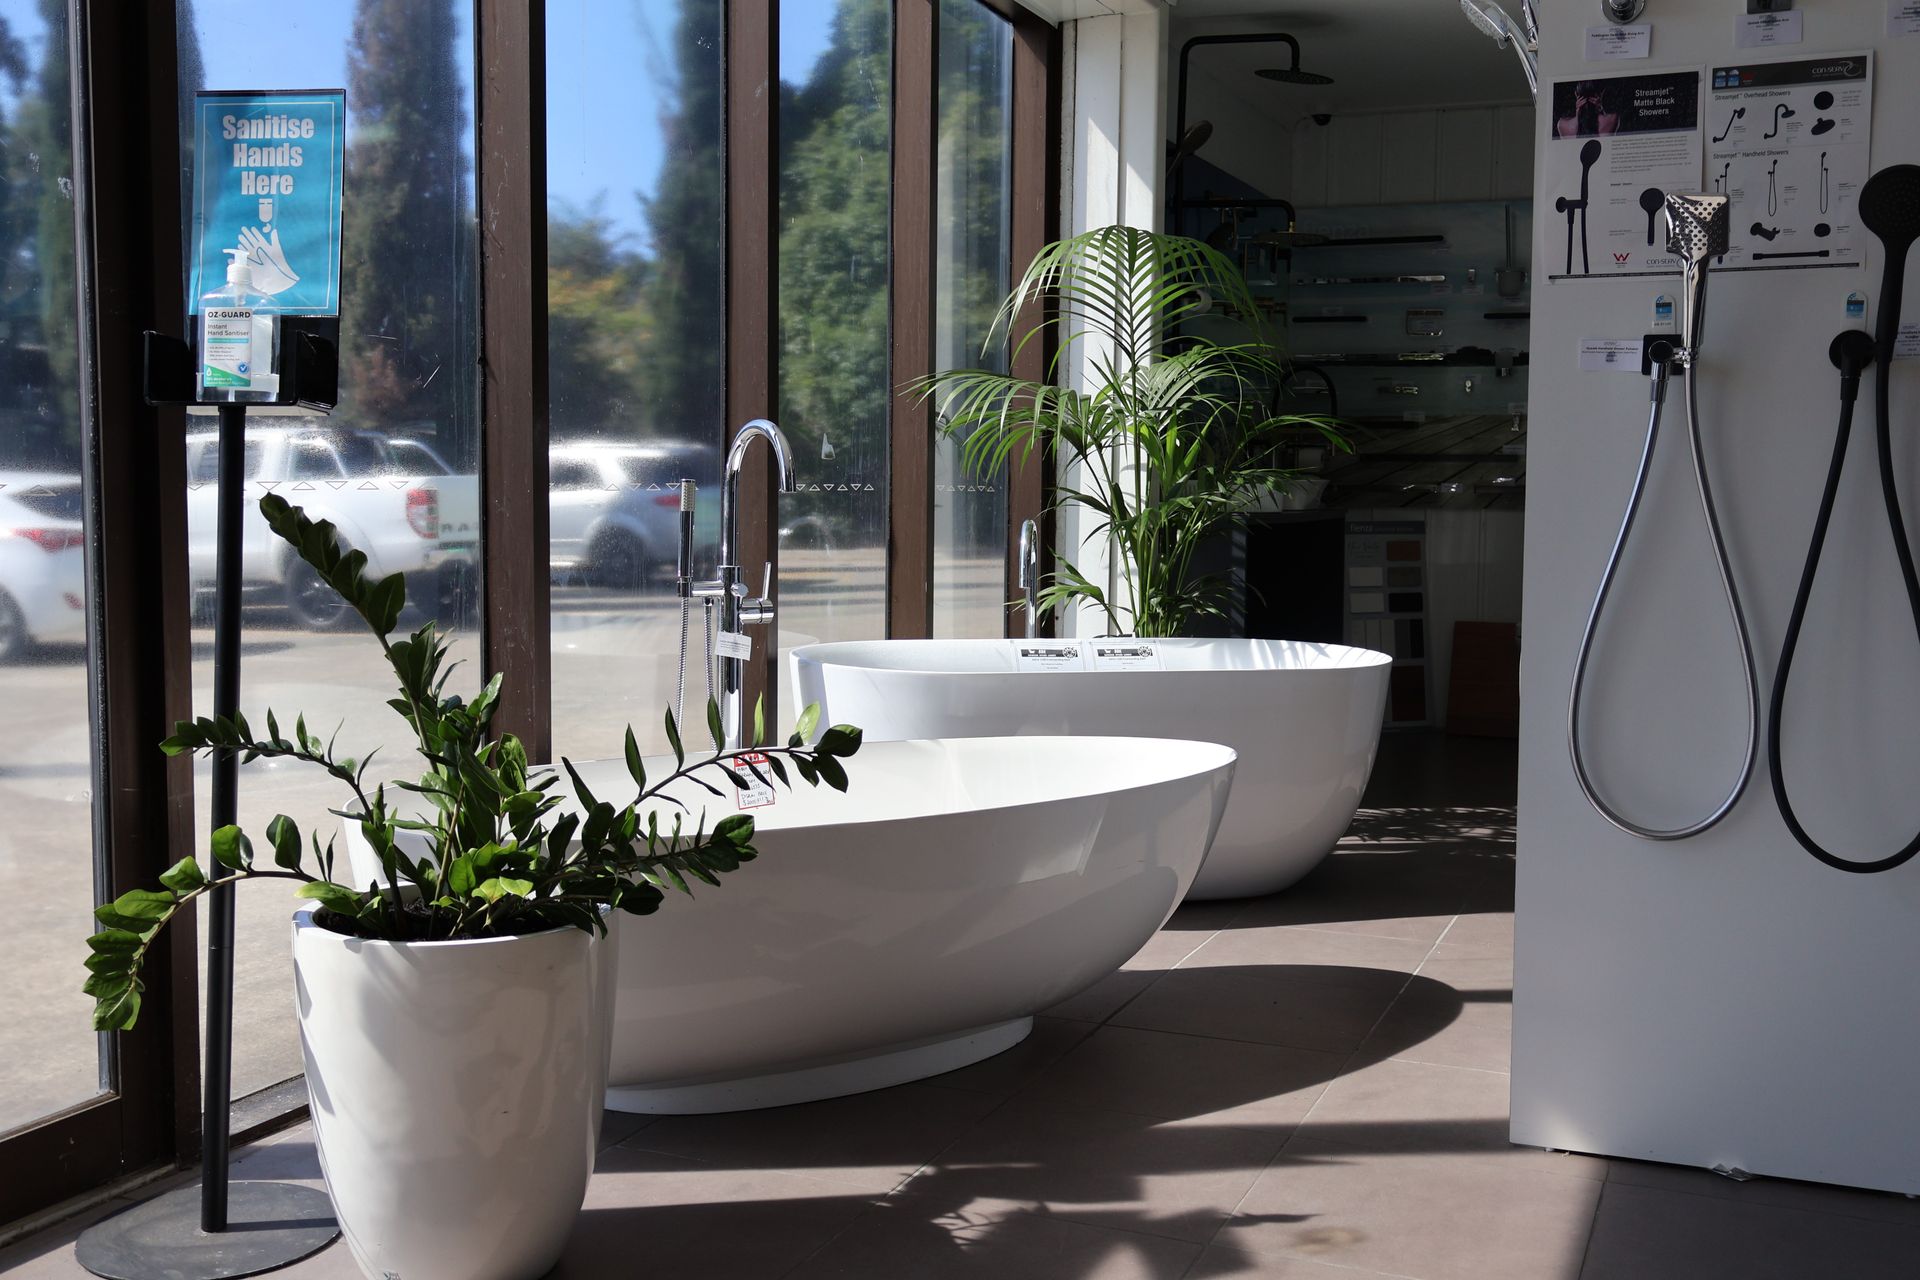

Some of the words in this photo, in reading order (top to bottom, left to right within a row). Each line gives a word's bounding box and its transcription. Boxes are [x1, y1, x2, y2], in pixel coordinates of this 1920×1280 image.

[1743, 91, 1769, 99] Overhead
[1768, 90, 1791, 98] Showers
[1633, 99, 1654, 107] Matte
[1655, 97, 1675, 105] Black
[1639, 108, 1669, 117] Showers
[222, 114, 315, 140] Sanitise
[233, 143, 303, 168] Hands
[1741, 150, 1766, 158] Handheld
[1766, 149, 1789, 157] Showers
[241, 171, 295, 195] Here
[207, 311, 251, 319] OZ-GUARD
